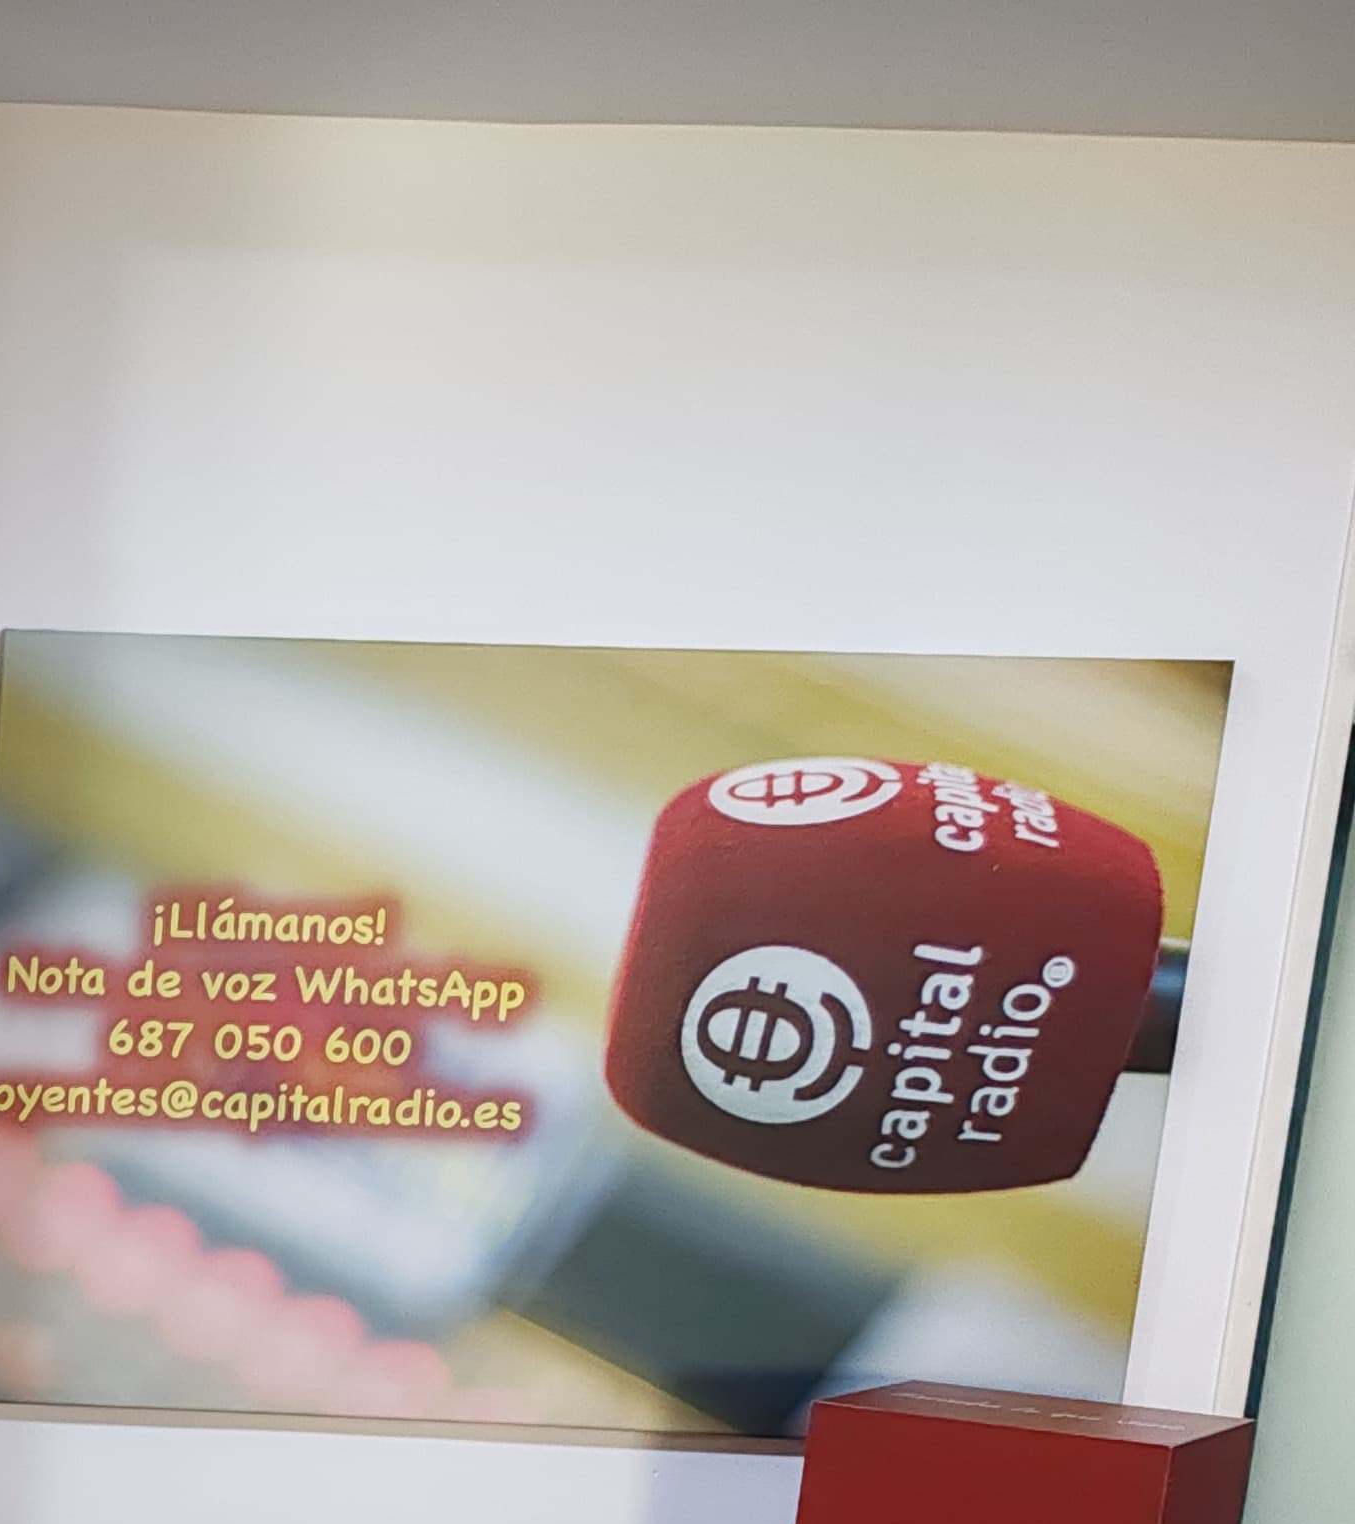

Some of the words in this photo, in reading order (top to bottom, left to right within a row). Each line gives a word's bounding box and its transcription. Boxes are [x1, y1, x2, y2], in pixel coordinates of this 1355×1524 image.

[152, 898, 387, 947] ¡Llámanos!
[7, 956, 106, 995] Nota
[128, 960, 181, 998] de
[202, 971, 277, 1002] voz
[294, 966, 526, 1021] WhatsApp
[109, 1019, 195, 1059] 687
[214, 1024, 303, 1062] 050
[325, 1027, 413, 1066] 600
[870, 943, 985, 1169] capital
